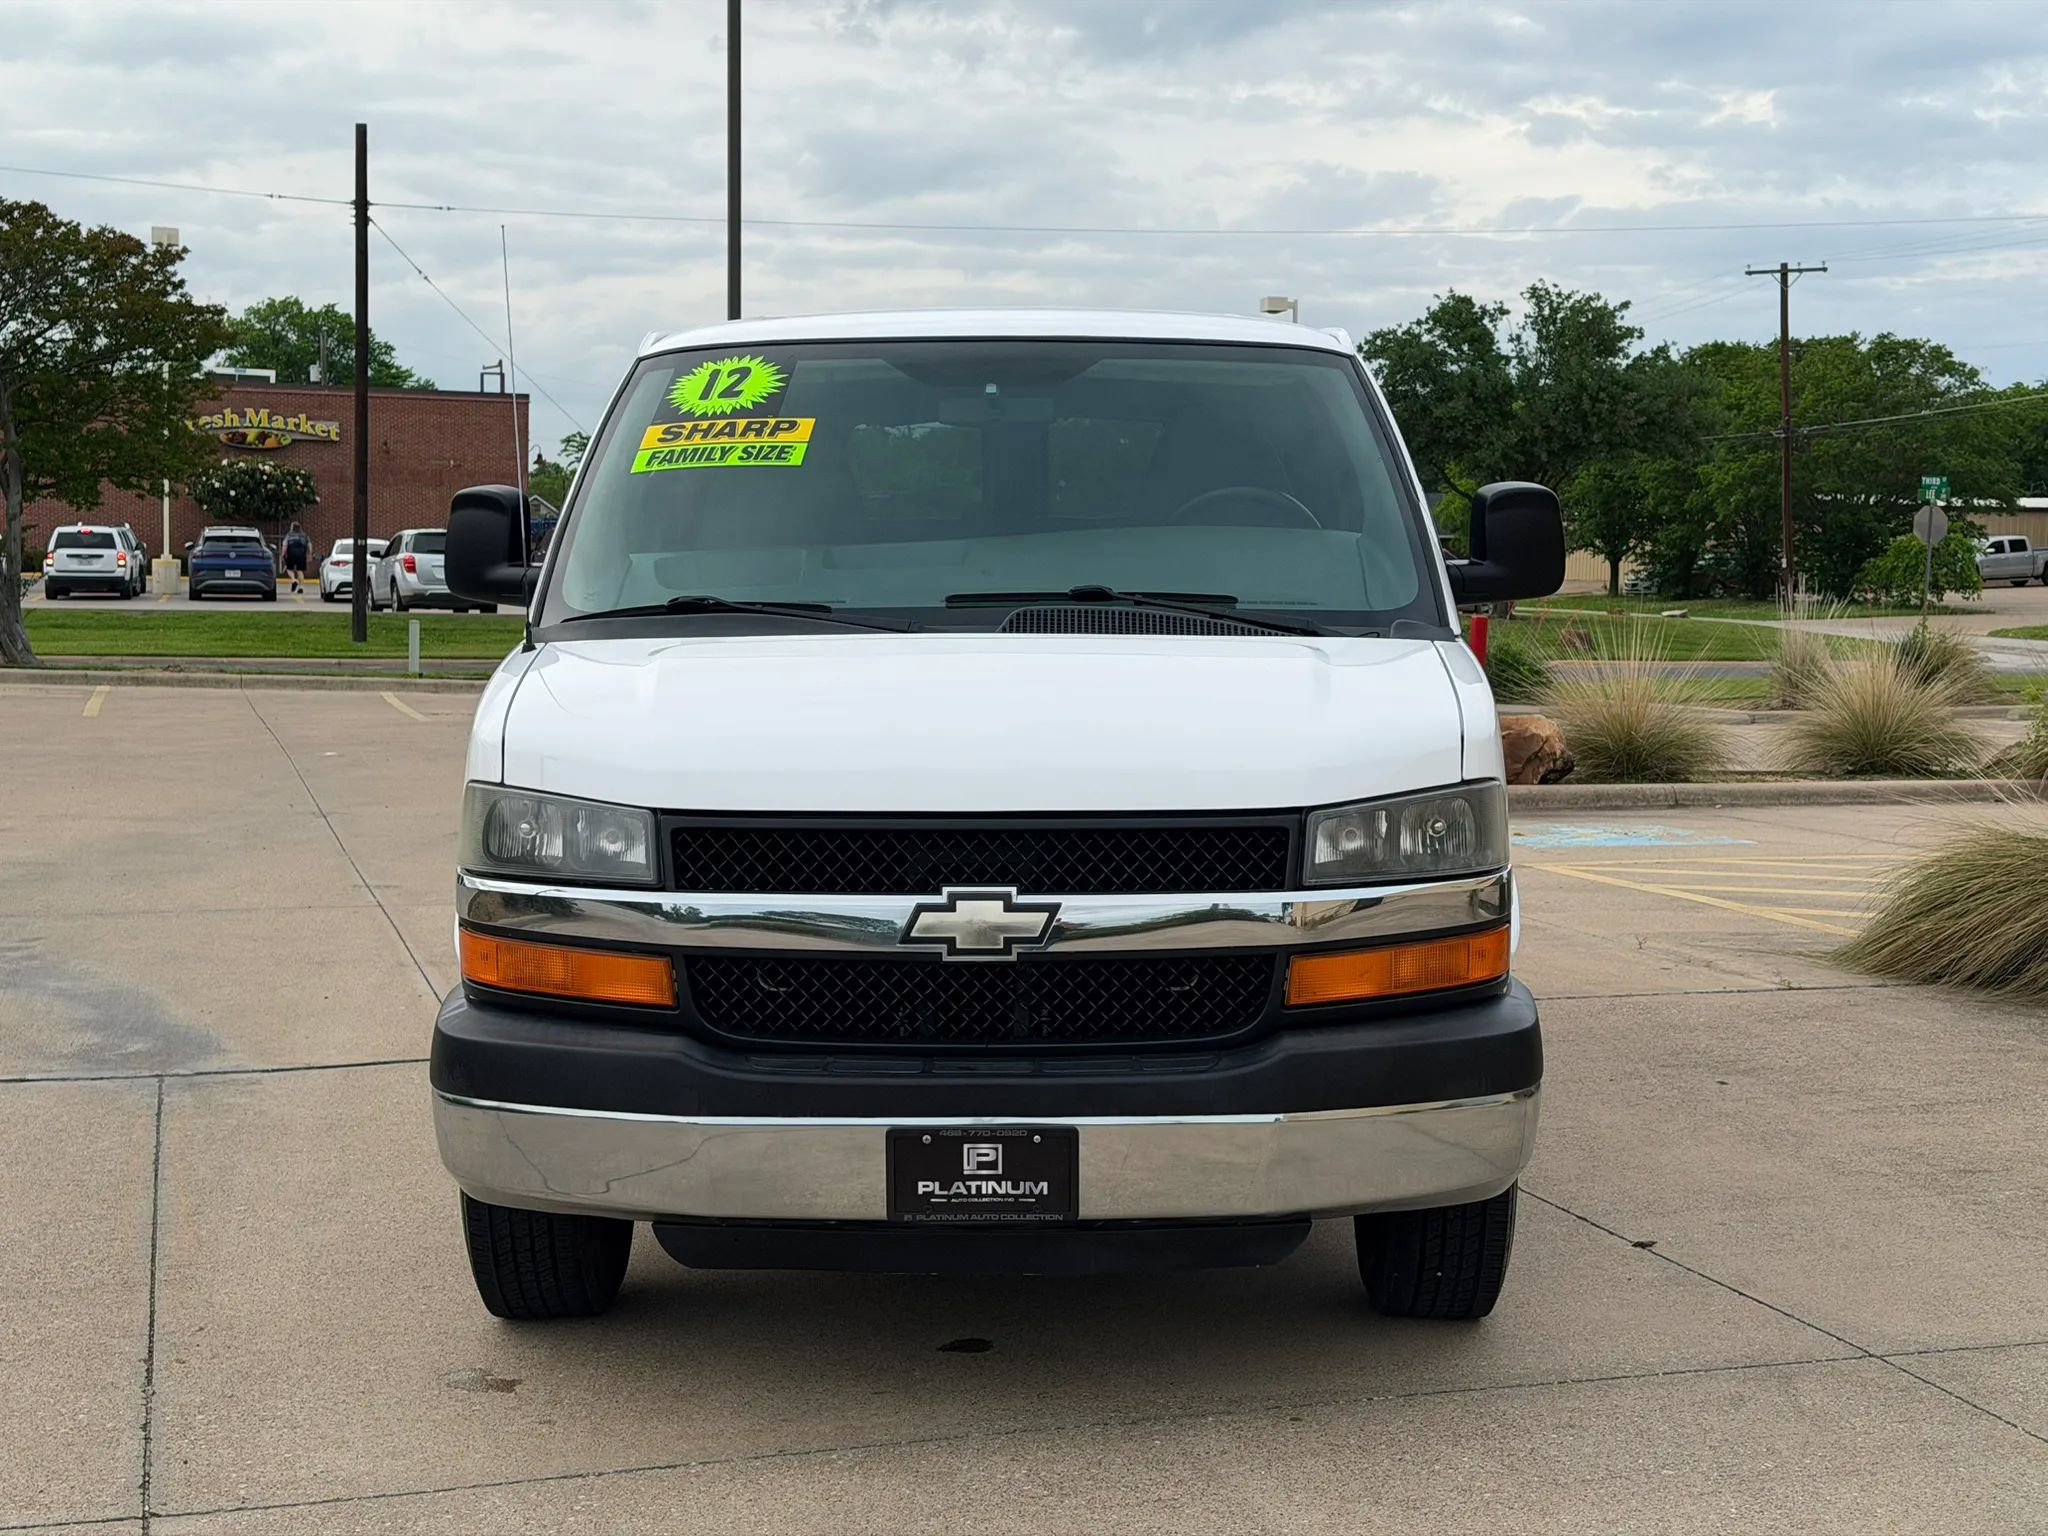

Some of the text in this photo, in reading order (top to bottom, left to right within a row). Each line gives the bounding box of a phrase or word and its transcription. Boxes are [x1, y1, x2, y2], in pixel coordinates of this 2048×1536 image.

[698, 366, 752, 402] 12
[184, 407, 340, 441] resh Market
[656, 420, 800, 443] SHARP
[645, 444, 796, 469] FAMILY SIZE
[1921, 476, 1940, 485] THIRD
[1925, 489, 1936, 499] LEE
[917, 1180, 1049, 1195] PLATINUM
[916, 1213, 969, 1221] PLATINUM
